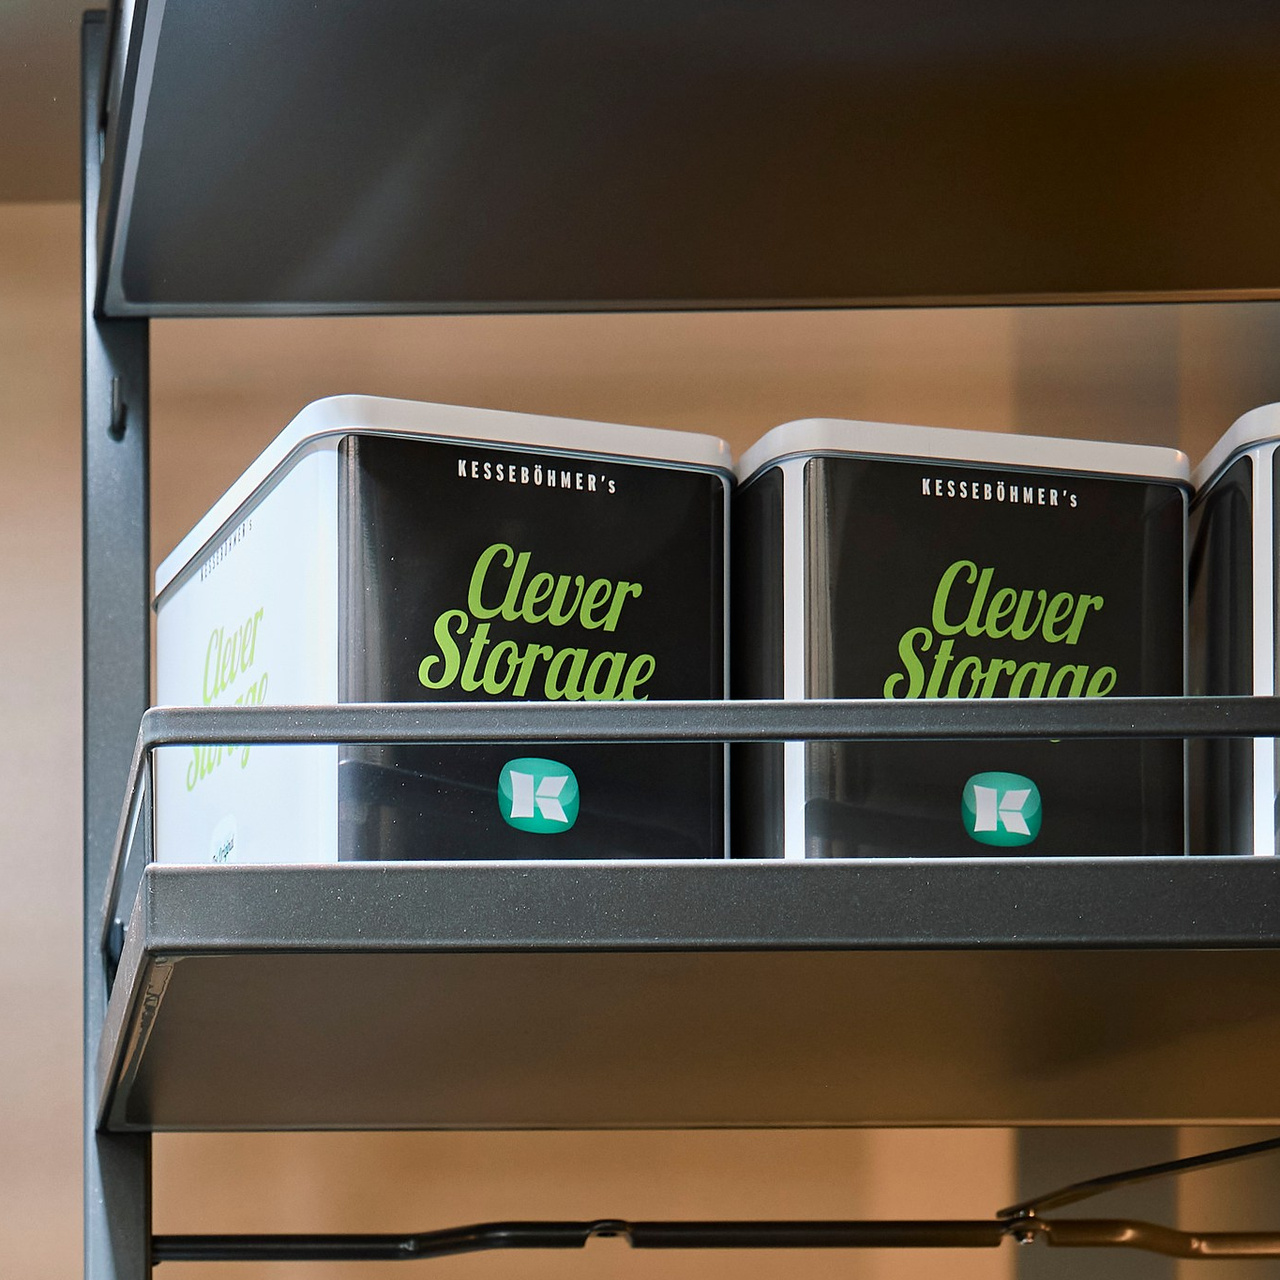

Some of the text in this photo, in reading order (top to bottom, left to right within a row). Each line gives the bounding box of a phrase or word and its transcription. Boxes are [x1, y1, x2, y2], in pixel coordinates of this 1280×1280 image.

[458, 459, 617, 494] KESSEBÖHMER's
[921, 478, 1078, 508] KESSEBÖHMER's
[467, 543, 642, 632] Clever
[931, 560, 1104, 645] Clever
[202, 607, 264, 705] Clever
